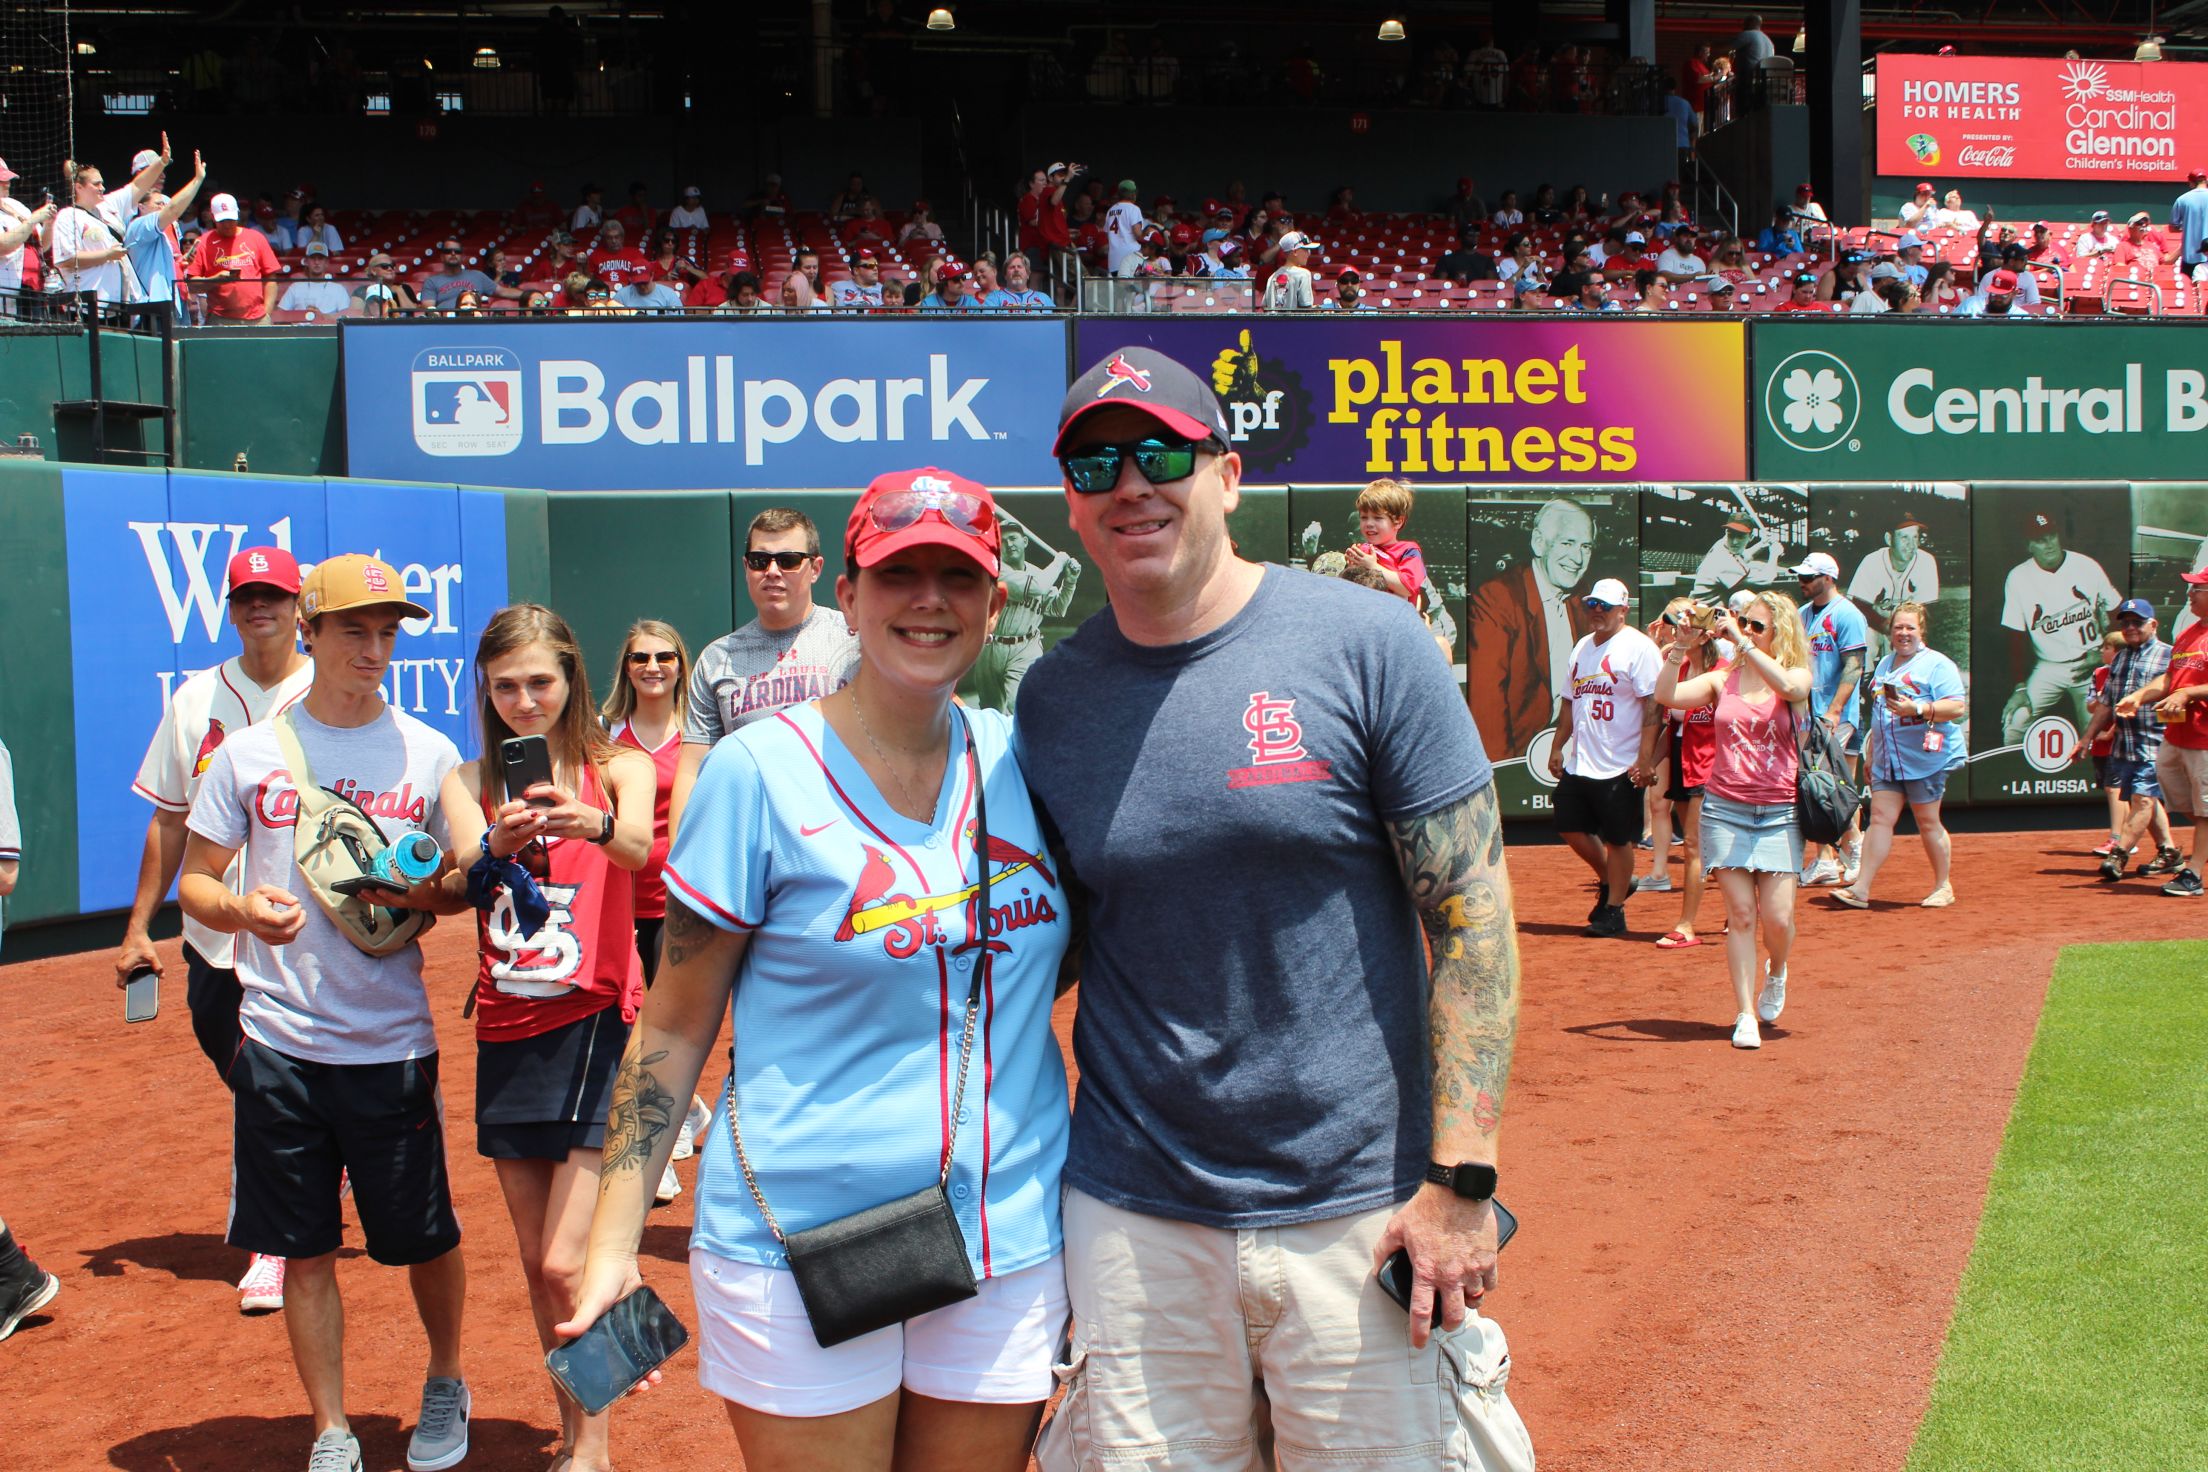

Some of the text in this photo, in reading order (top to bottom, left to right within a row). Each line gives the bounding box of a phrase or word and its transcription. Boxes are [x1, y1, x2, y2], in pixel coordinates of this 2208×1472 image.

[1903, 80, 2020, 105] HOMERS
[2105, 89, 2175, 103] SSMHealth
[1903, 105, 2020, 121] FOR HEALTH
[2065, 103, 2175, 130] Cardinal
[1962, 133, 2013, 142] PRESENTED BY:
[2065, 129, 2174, 157] Glennon
[2065, 157, 2122, 170] Children's
[428, 354, 505, 368] BALLPARK
[1327, 340, 1587, 424] planet
[539, 353, 992, 466] Ballpark
[1887, 363, 2143, 435] Central
[1229, 390, 1285, 441] pf
[431, 440, 507, 449] SEC ROW SEAT
[1365, 407, 1638, 472] fitness
[2041, 606, 2093, 634] Cardinals
[2078, 621, 2098, 646] 10
[779, 664, 830, 677] LOUIS
[1591, 699, 1615, 722] 50
[2038, 729, 2064, 759] 10
[2011, 779, 2088, 795] LA RUSSA
[951, 886, 1058, 956] Louis
